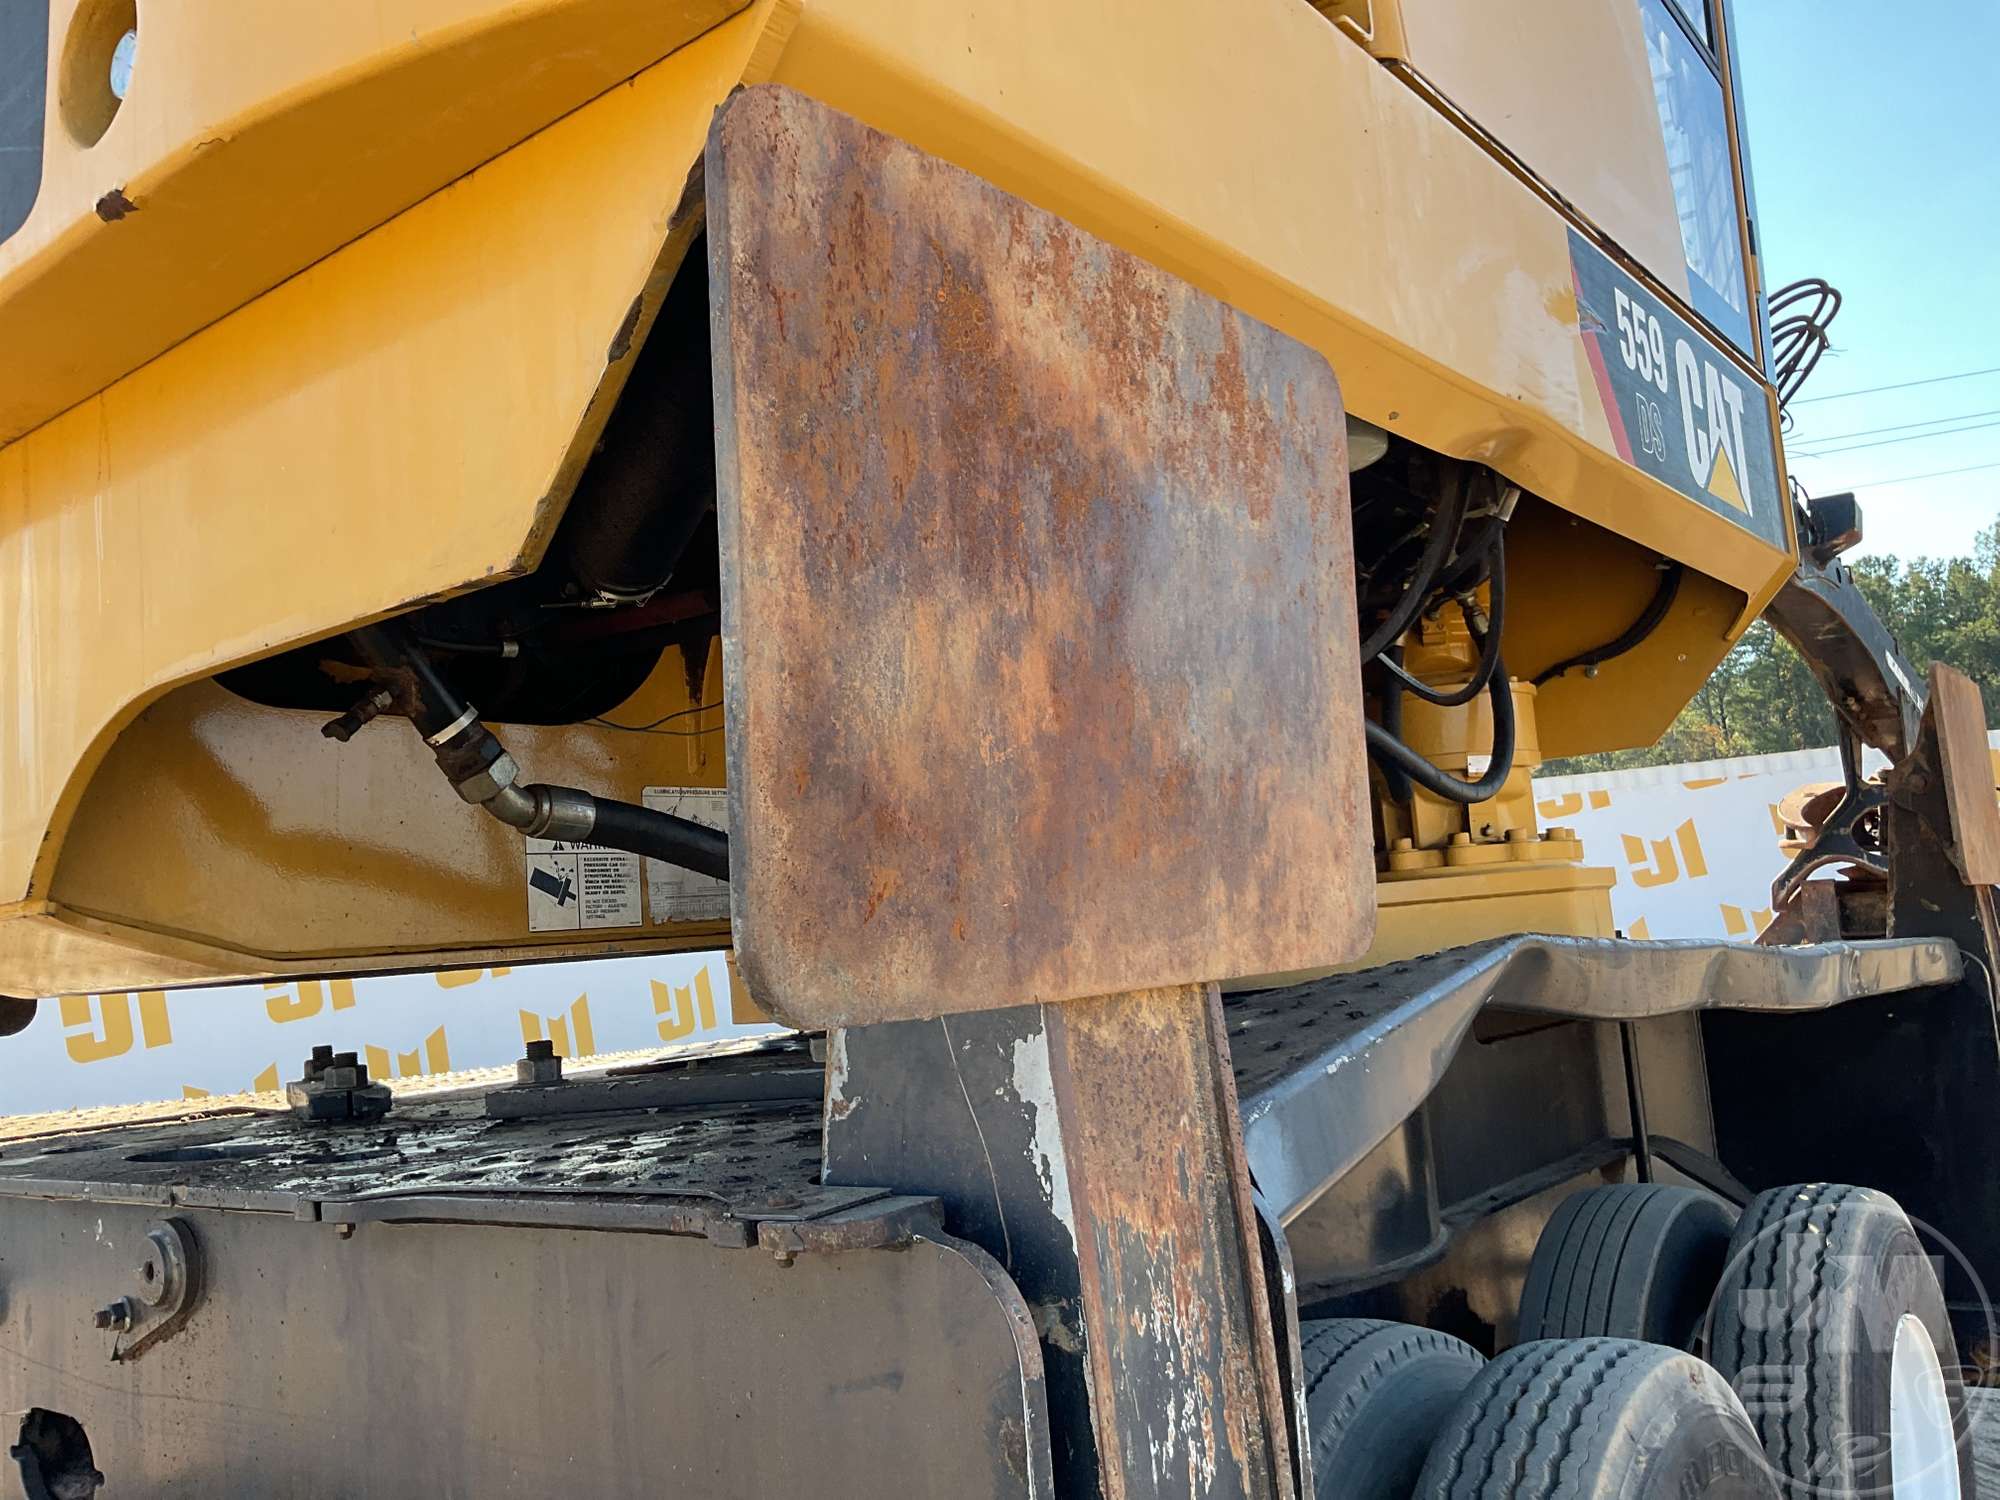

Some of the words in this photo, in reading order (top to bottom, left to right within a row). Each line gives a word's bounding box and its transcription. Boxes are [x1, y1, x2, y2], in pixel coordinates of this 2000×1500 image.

[1615, 287, 1668, 394] 559
[1636, 392, 1666, 463] DS
[1675, 338, 1754, 519] CAT
